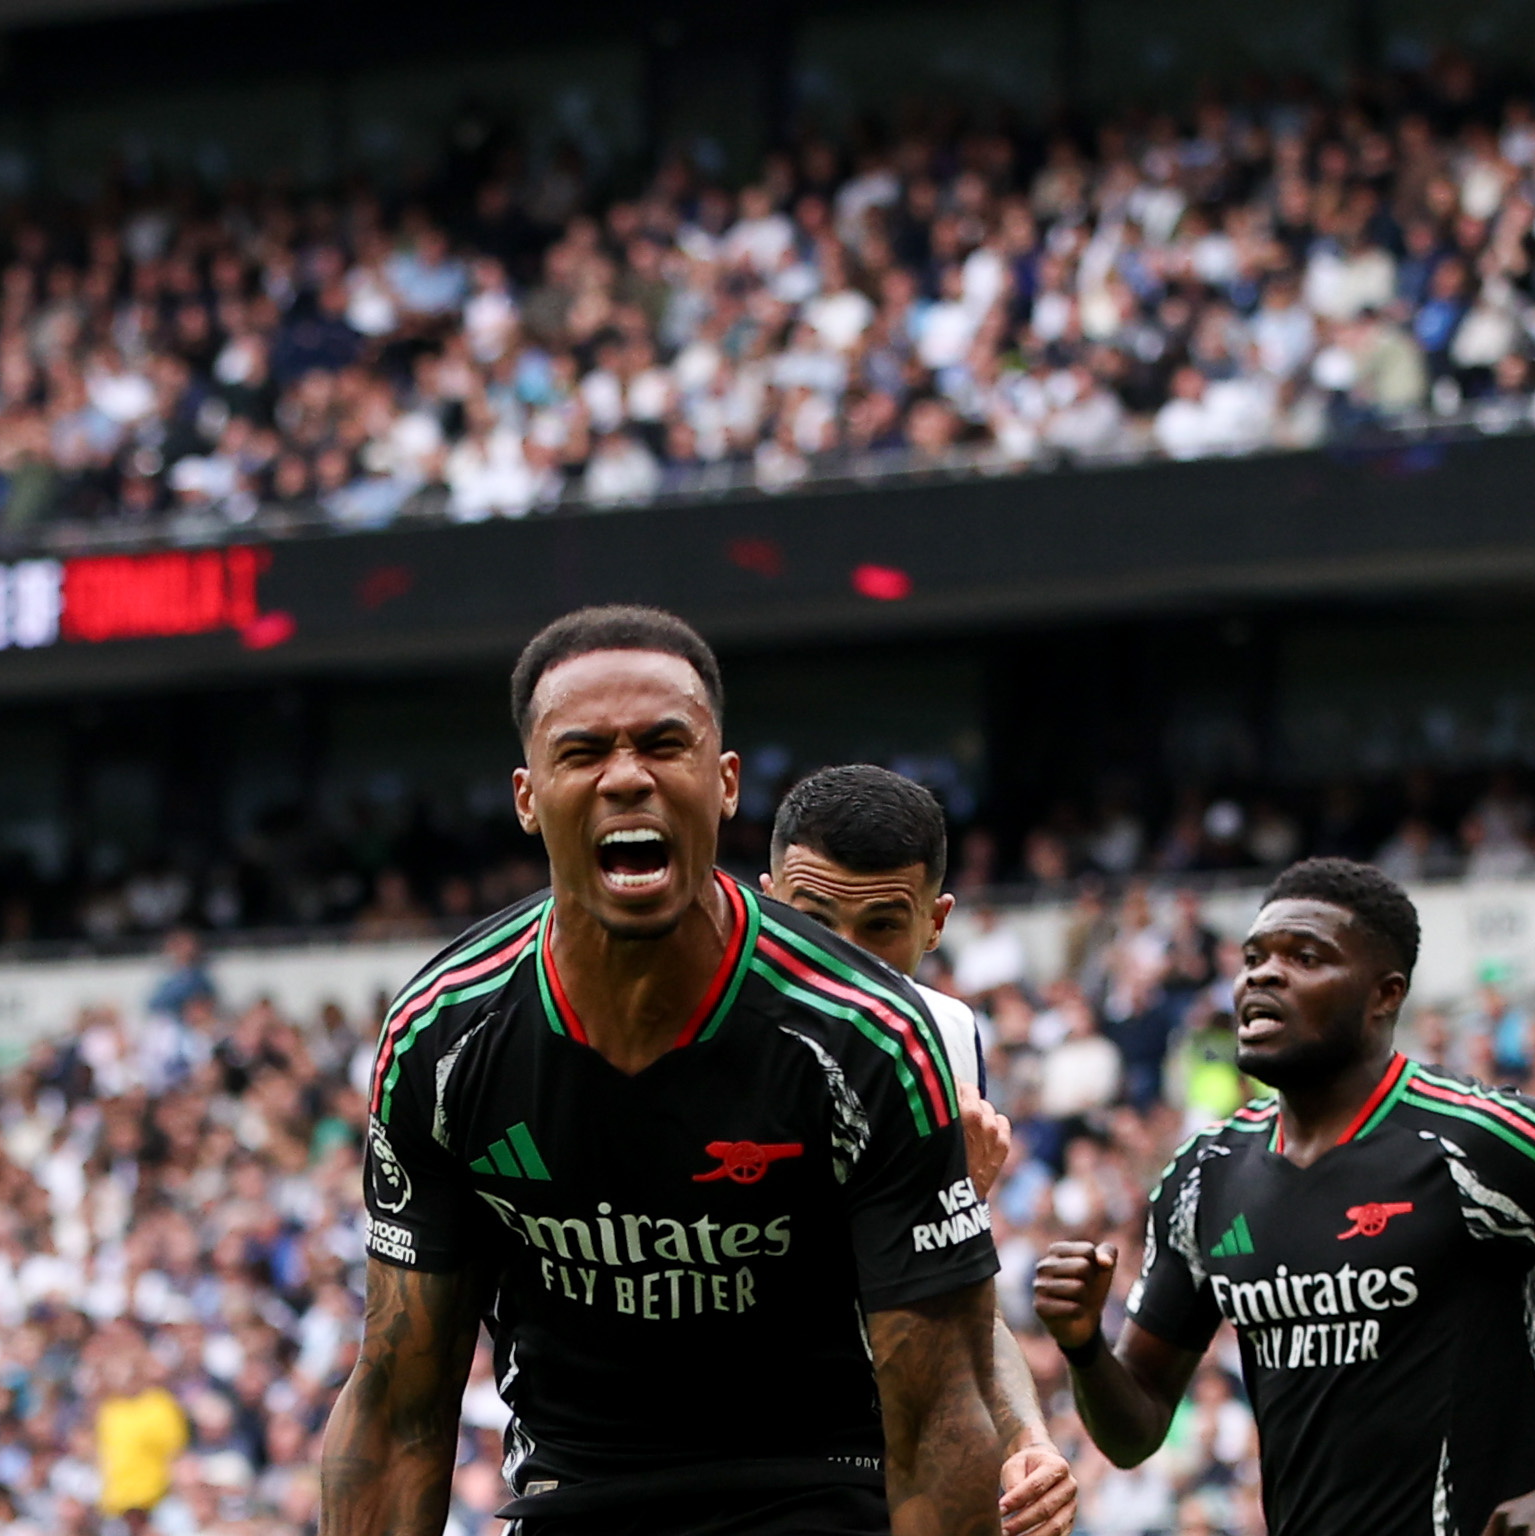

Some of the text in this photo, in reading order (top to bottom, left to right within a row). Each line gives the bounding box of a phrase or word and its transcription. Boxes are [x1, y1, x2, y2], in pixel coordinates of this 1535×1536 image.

[938, 1176, 978, 1215] VISI
[372, 1235, 416, 1265] racism
[374, 1220, 412, 1247] room
[476, 1188, 792, 1266] Emirates
[912, 1202, 991, 1253] RWAN
[541, 1256, 757, 1320] FLY BETTER
[1209, 1262, 1420, 1327] Emirates
[1286, 1319, 1381, 1370] BETTER
